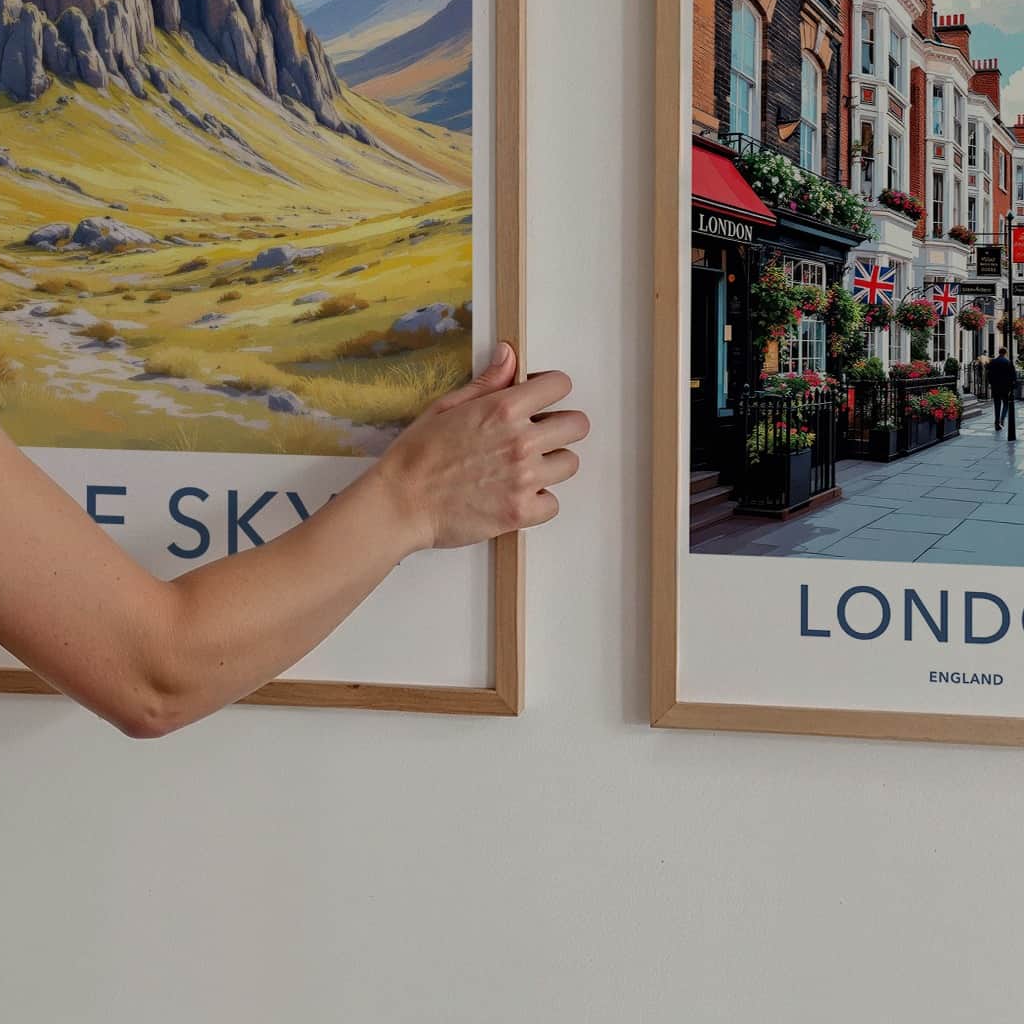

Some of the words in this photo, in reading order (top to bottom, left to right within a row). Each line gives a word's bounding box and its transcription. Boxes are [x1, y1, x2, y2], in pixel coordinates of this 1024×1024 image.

[698, 213, 753, 242] LONDON
[800, 584, 1024, 645] LOND
[929, 670, 1004, 686] ENGLAND
